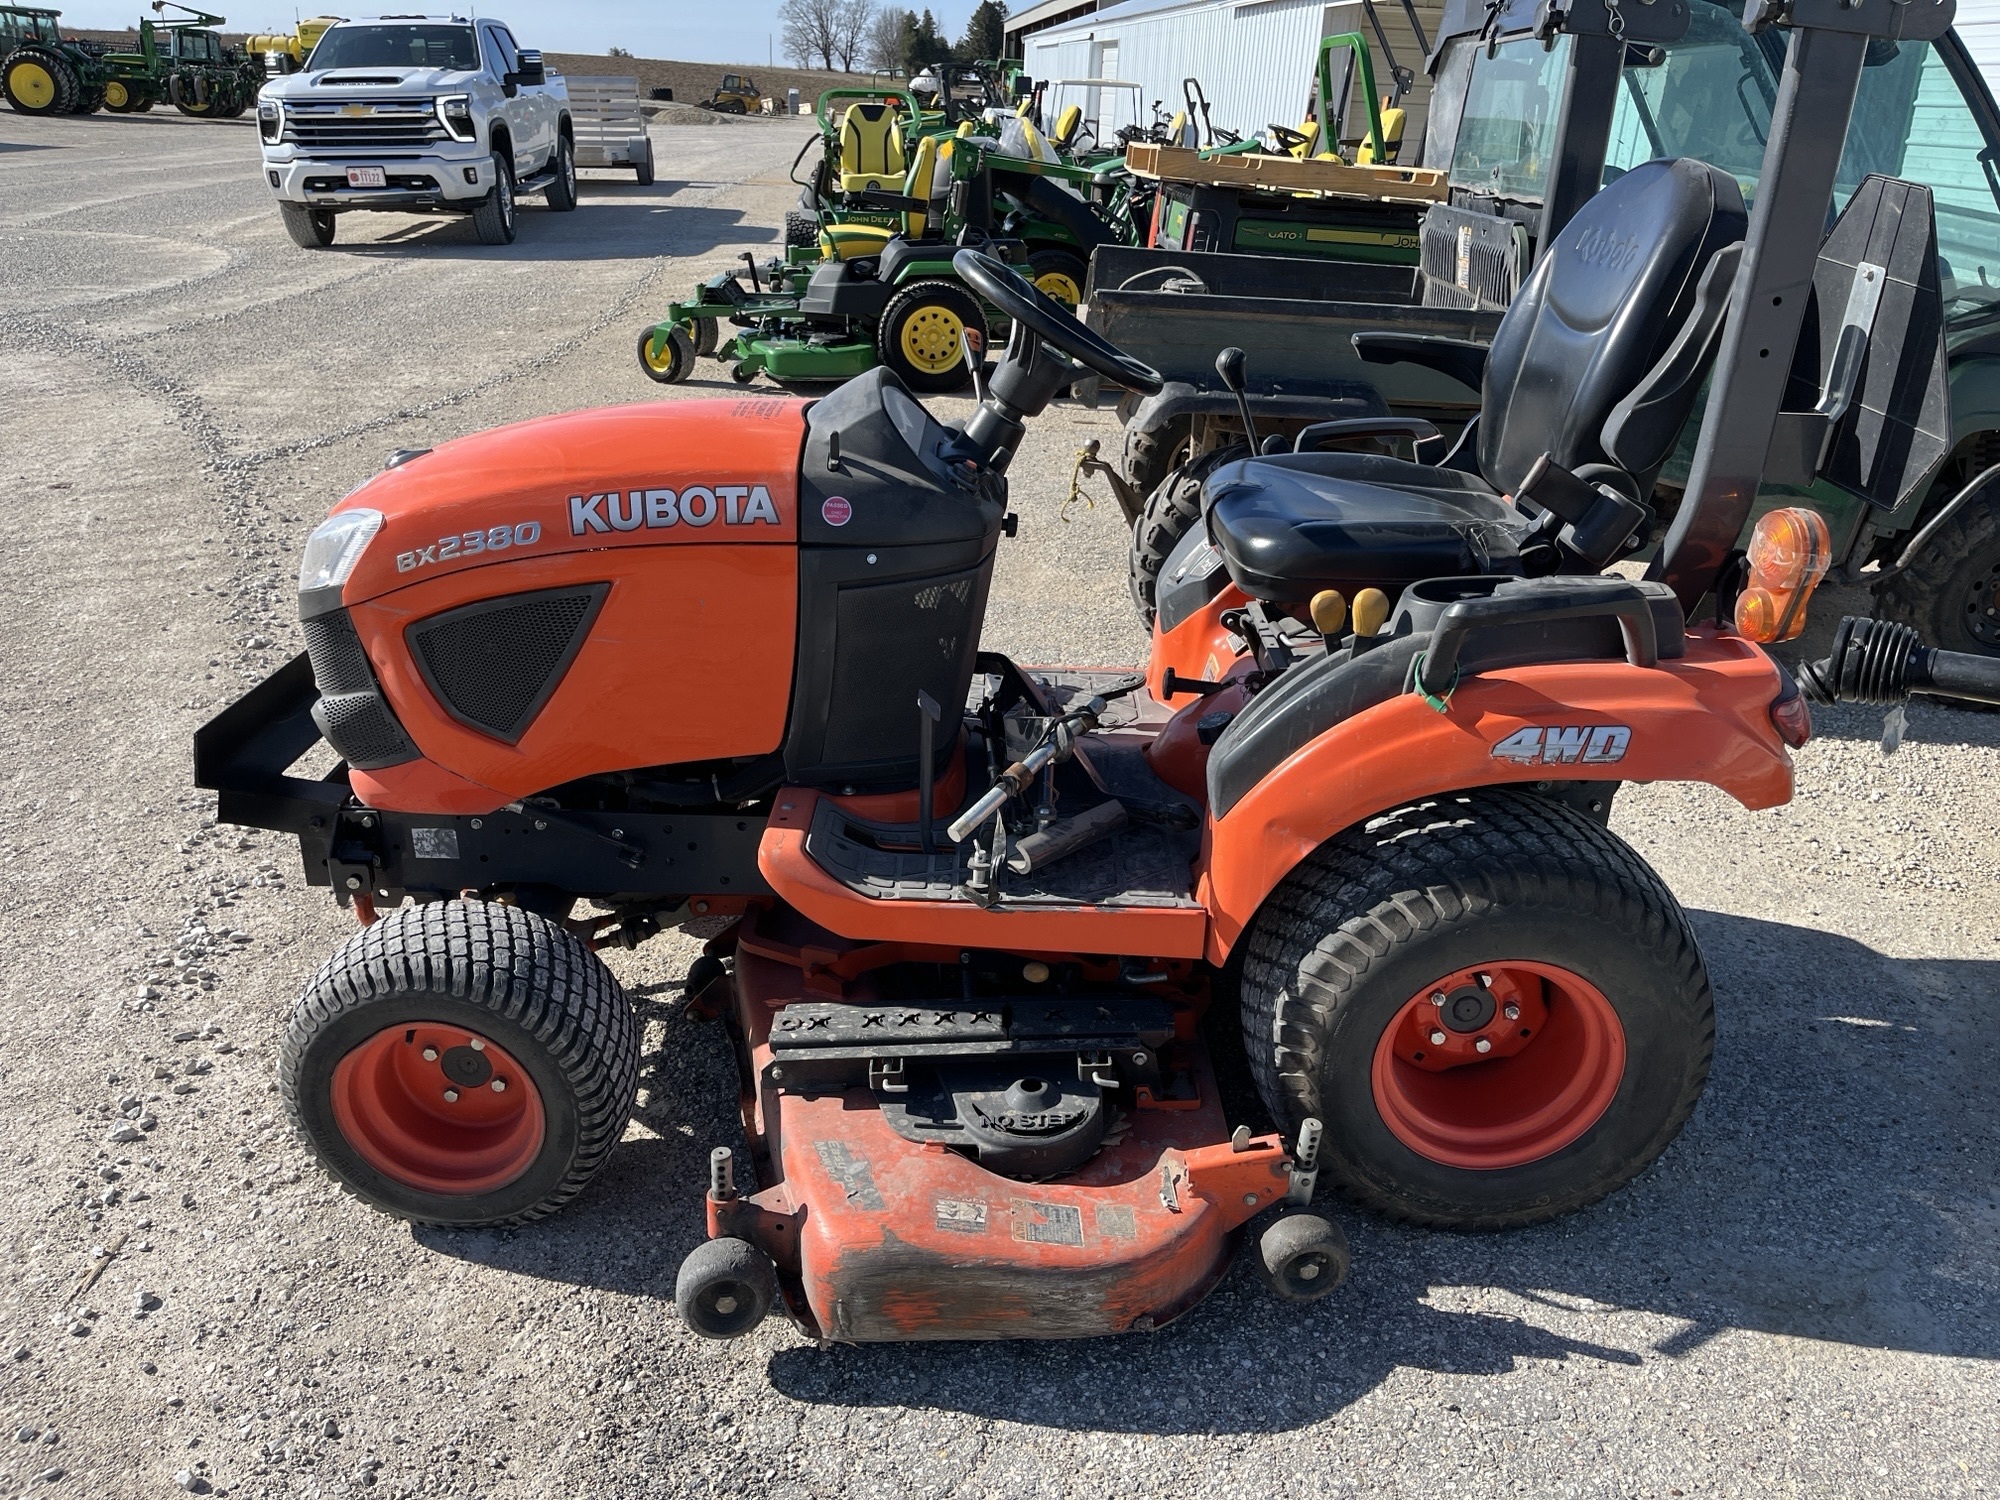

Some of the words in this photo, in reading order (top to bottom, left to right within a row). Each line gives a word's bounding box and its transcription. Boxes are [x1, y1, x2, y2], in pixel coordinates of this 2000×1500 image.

[845, 215, 870, 223] JOHN
[570, 485, 781, 536] KUBOTA
[396, 521, 542, 573] BX2380
[1490, 725, 1632, 763] 4WD
[980, 1113, 1015, 1131] NO
[1019, 1113, 1076, 1129] STEP
[814, 1140, 840, 1180] Mower
